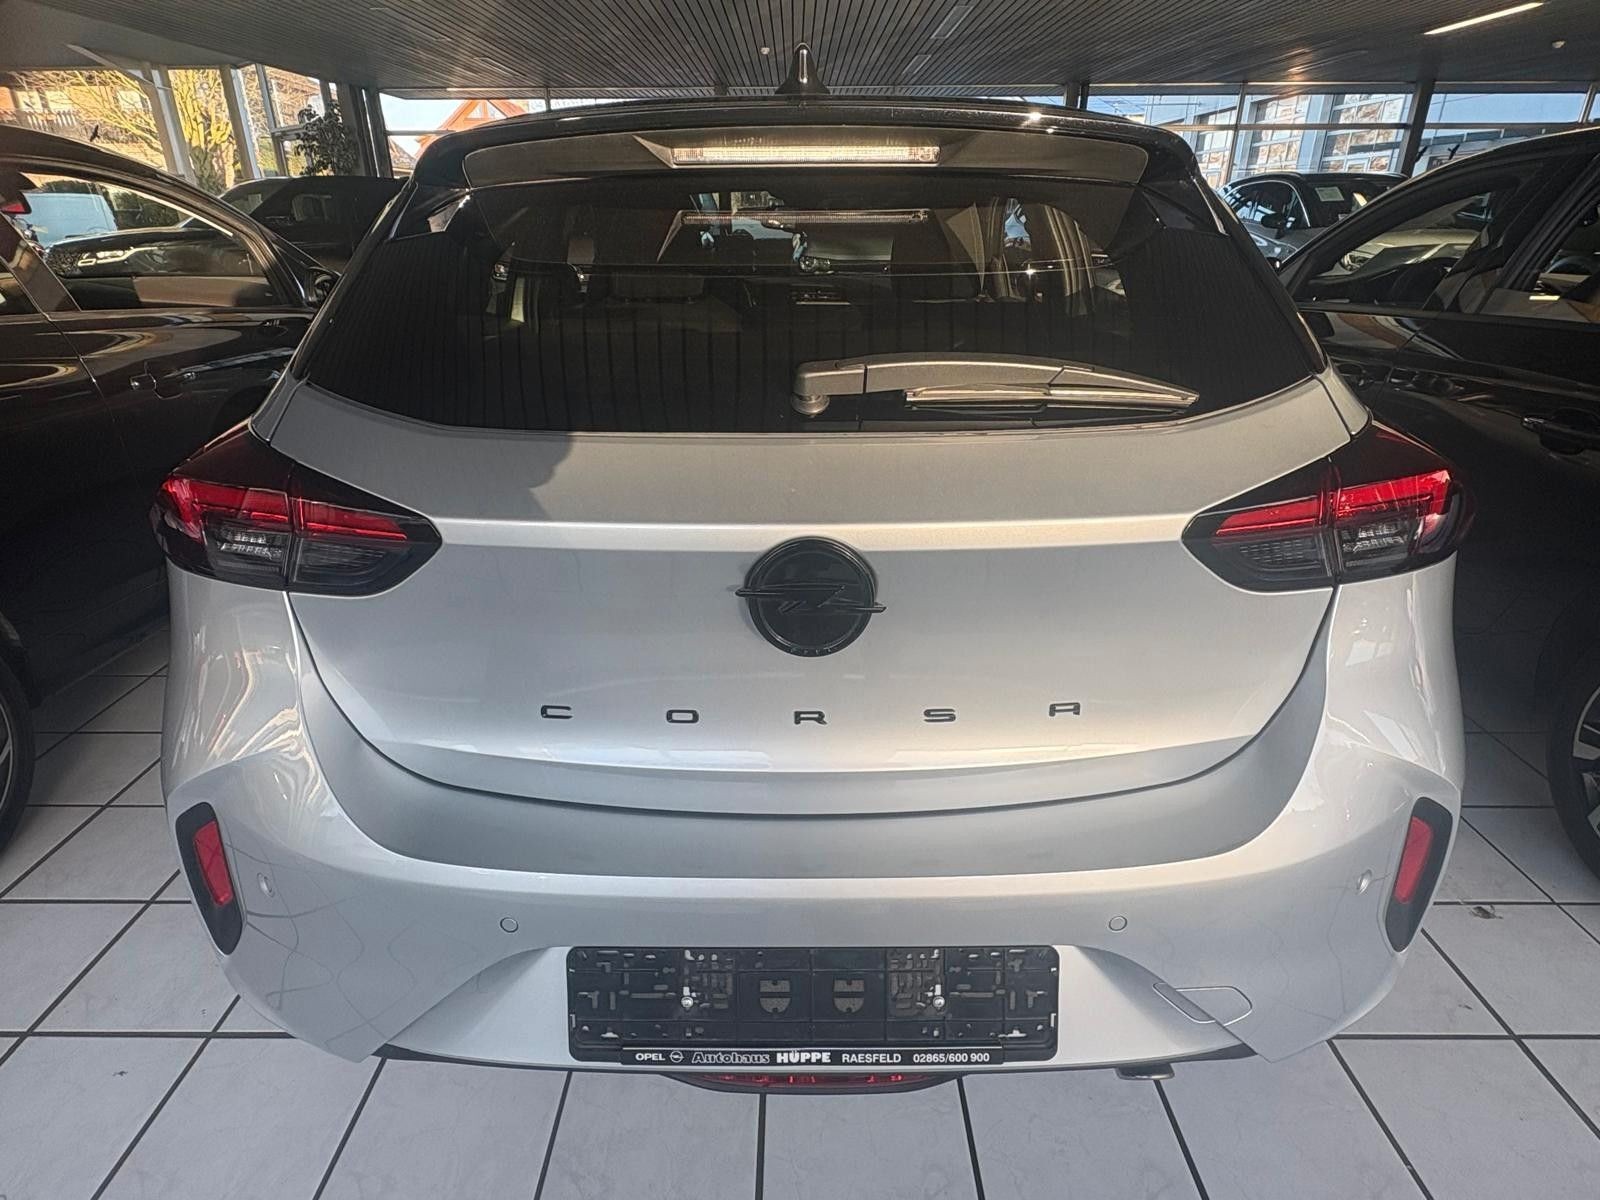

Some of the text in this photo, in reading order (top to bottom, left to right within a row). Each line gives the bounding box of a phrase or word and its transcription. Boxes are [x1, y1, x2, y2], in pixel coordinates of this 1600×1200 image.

[540, 702, 1081, 725] CORSA
[635, 1050, 990, 1064] OPEL Autohaus HÜPPE RAESFELD 02865/600 900
